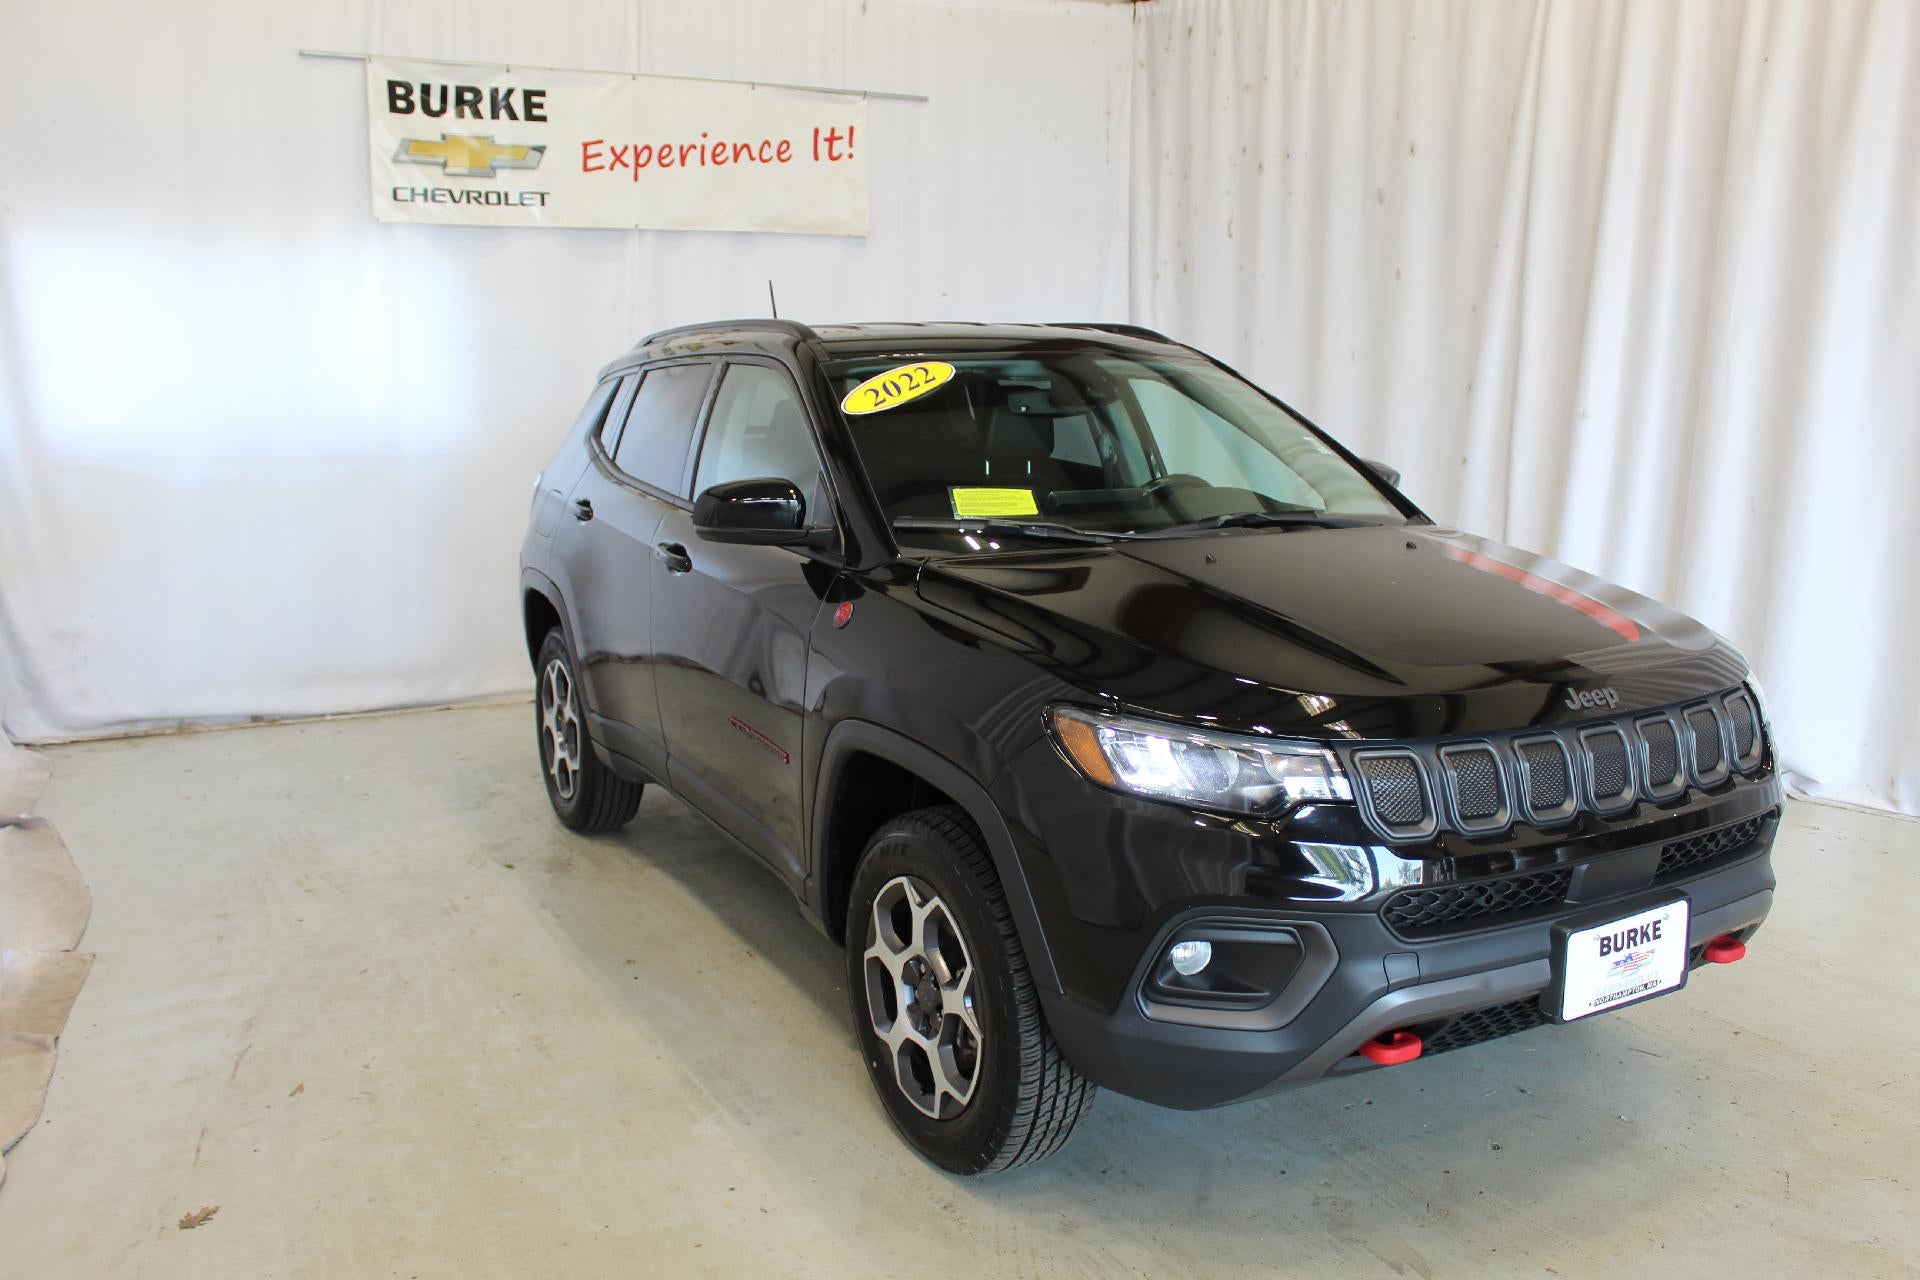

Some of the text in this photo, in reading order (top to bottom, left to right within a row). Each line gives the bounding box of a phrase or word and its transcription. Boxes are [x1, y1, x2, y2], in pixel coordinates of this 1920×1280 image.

[387, 80, 547, 122] BURKE
[582, 126, 854, 182] Experience It!
[393, 187, 550, 207] CHEVROLET
[864, 366, 936, 407] 2022
[1565, 687, 1619, 710] Jeep
[1600, 919, 1662, 957] BURKE
